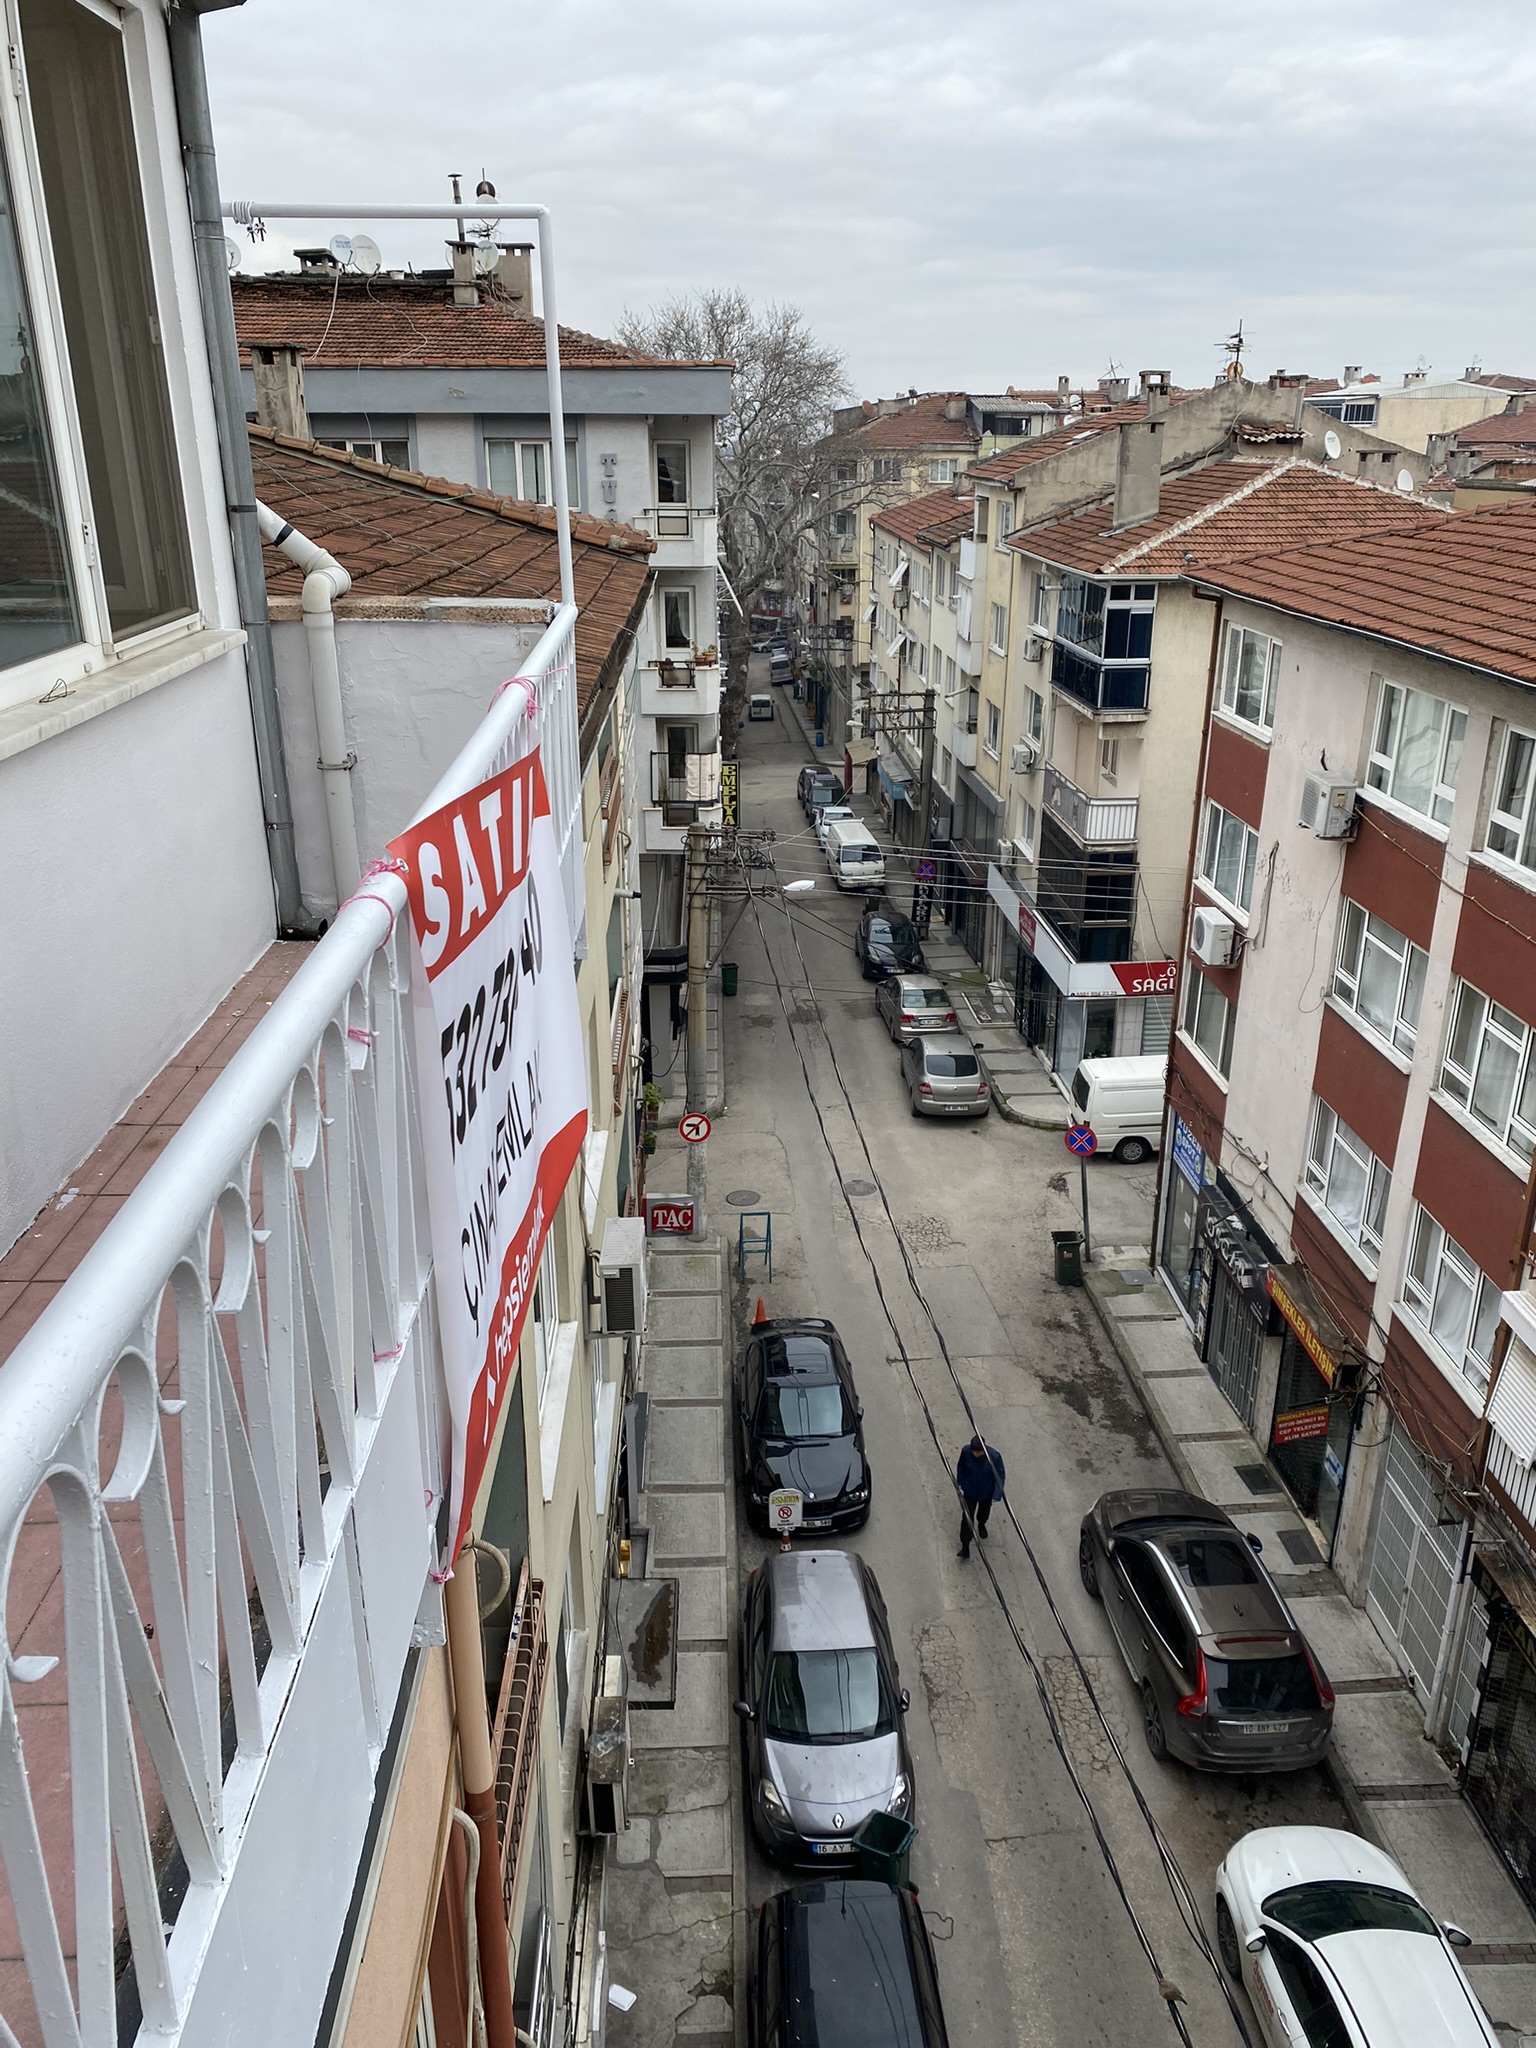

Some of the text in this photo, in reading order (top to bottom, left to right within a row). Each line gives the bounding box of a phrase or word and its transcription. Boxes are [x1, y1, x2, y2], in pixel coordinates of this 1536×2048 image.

[722, 765, 736, 825] EMELYA
[818, 1845, 828, 1853] 16
[832, 1844, 845, 1852] AY
